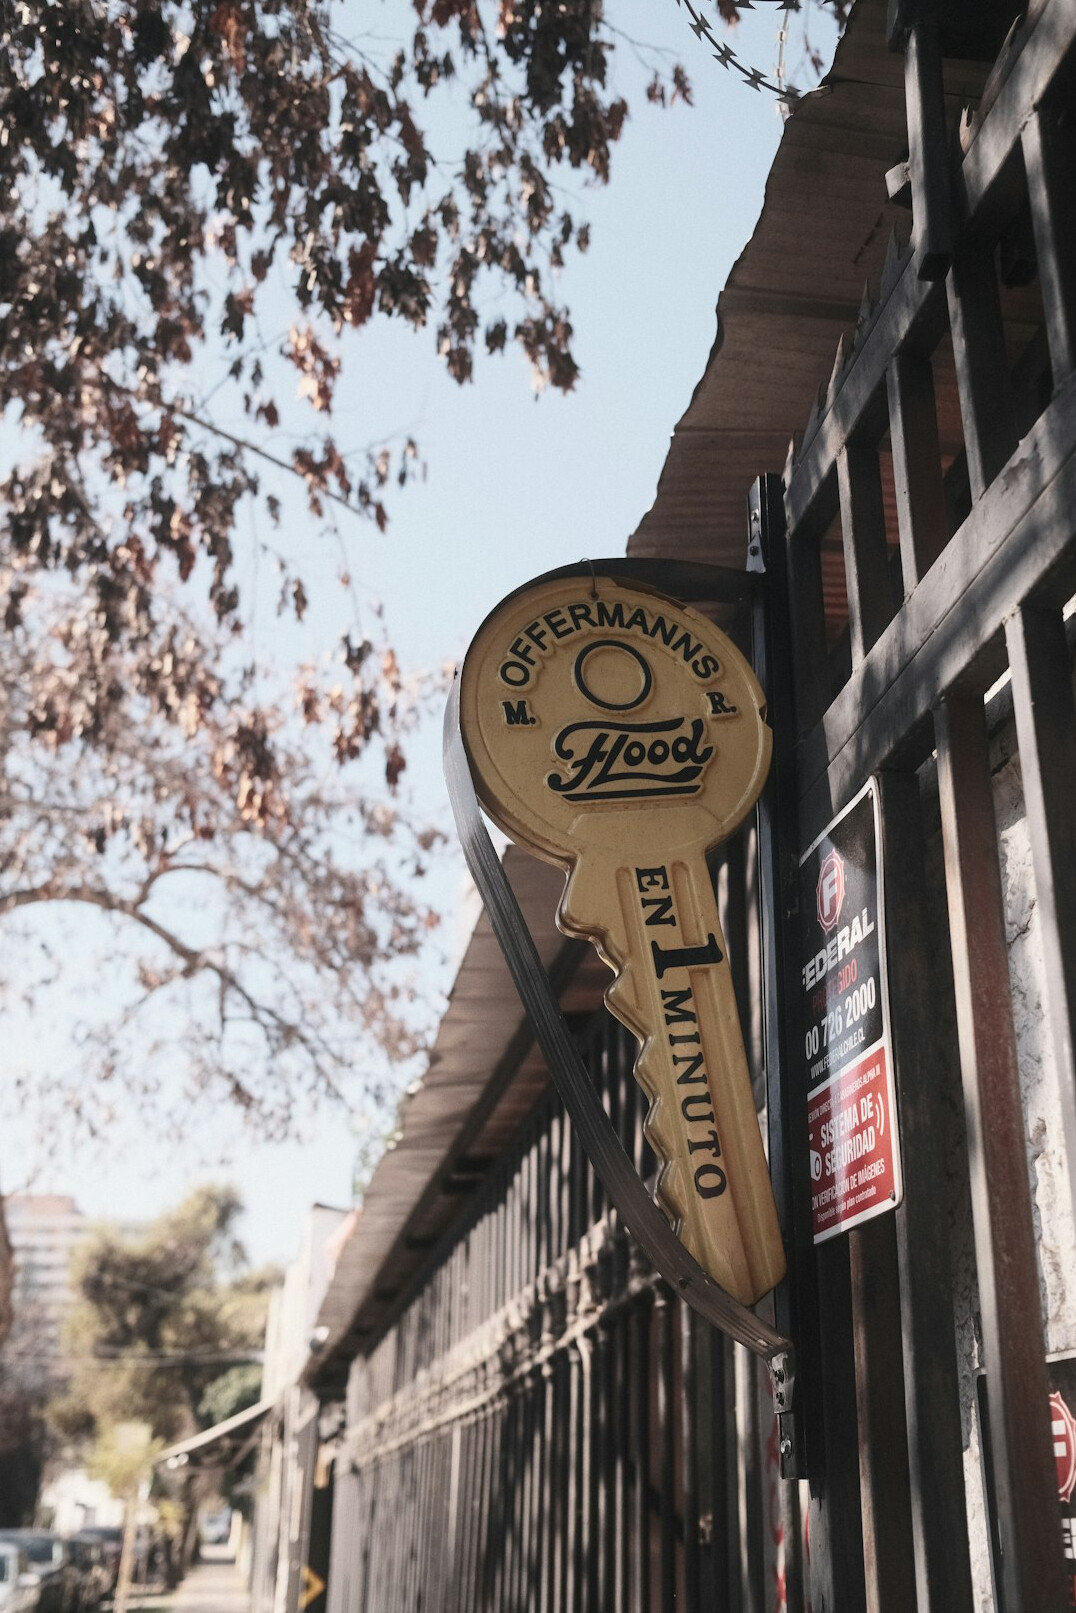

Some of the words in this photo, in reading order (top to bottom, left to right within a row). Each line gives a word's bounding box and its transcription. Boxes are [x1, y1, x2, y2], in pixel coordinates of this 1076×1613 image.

[500, 602, 719, 686] OFFERMANNS
[502, 700, 536, 725] M.
[706, 691, 737, 715] R.
[635, 865, 677, 927] EN
[822, 866, 838, 919] F
[651, 932, 723, 979] 1
[821, 1005, 843, 1047] 726
[845, 976, 876, 1029] 2000
[660, 987, 727, 1199] MINUTO
[820, 1103, 860, 1149] SISTEMA
[860, 1092, 875, 1123] DE
[825, 1125, 876, 1177] SEGURIDAD
[850, 1172, 858, 1190] DE
